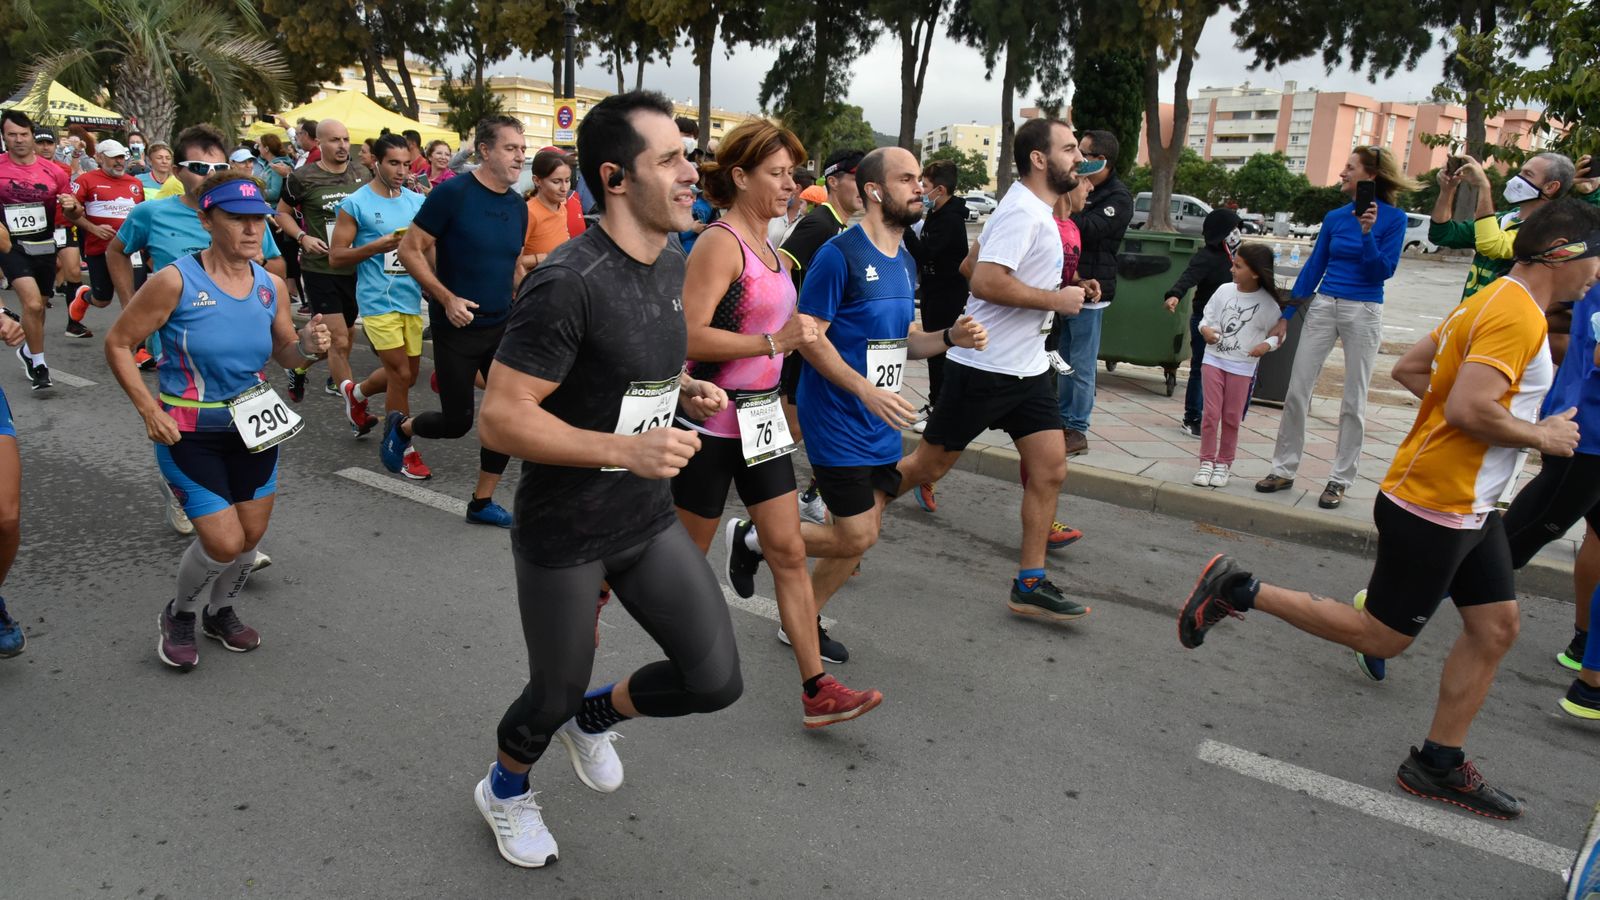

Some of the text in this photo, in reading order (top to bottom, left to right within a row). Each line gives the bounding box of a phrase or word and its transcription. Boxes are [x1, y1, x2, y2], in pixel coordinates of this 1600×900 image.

[13, 216, 36, 228] 129
[391, 252, 404, 267] 2
[1216, 340, 1240, 352] Bambi
[875, 363, 902, 388] 287
[248, 403, 289, 438] 290
[756, 420, 772, 448] 76
